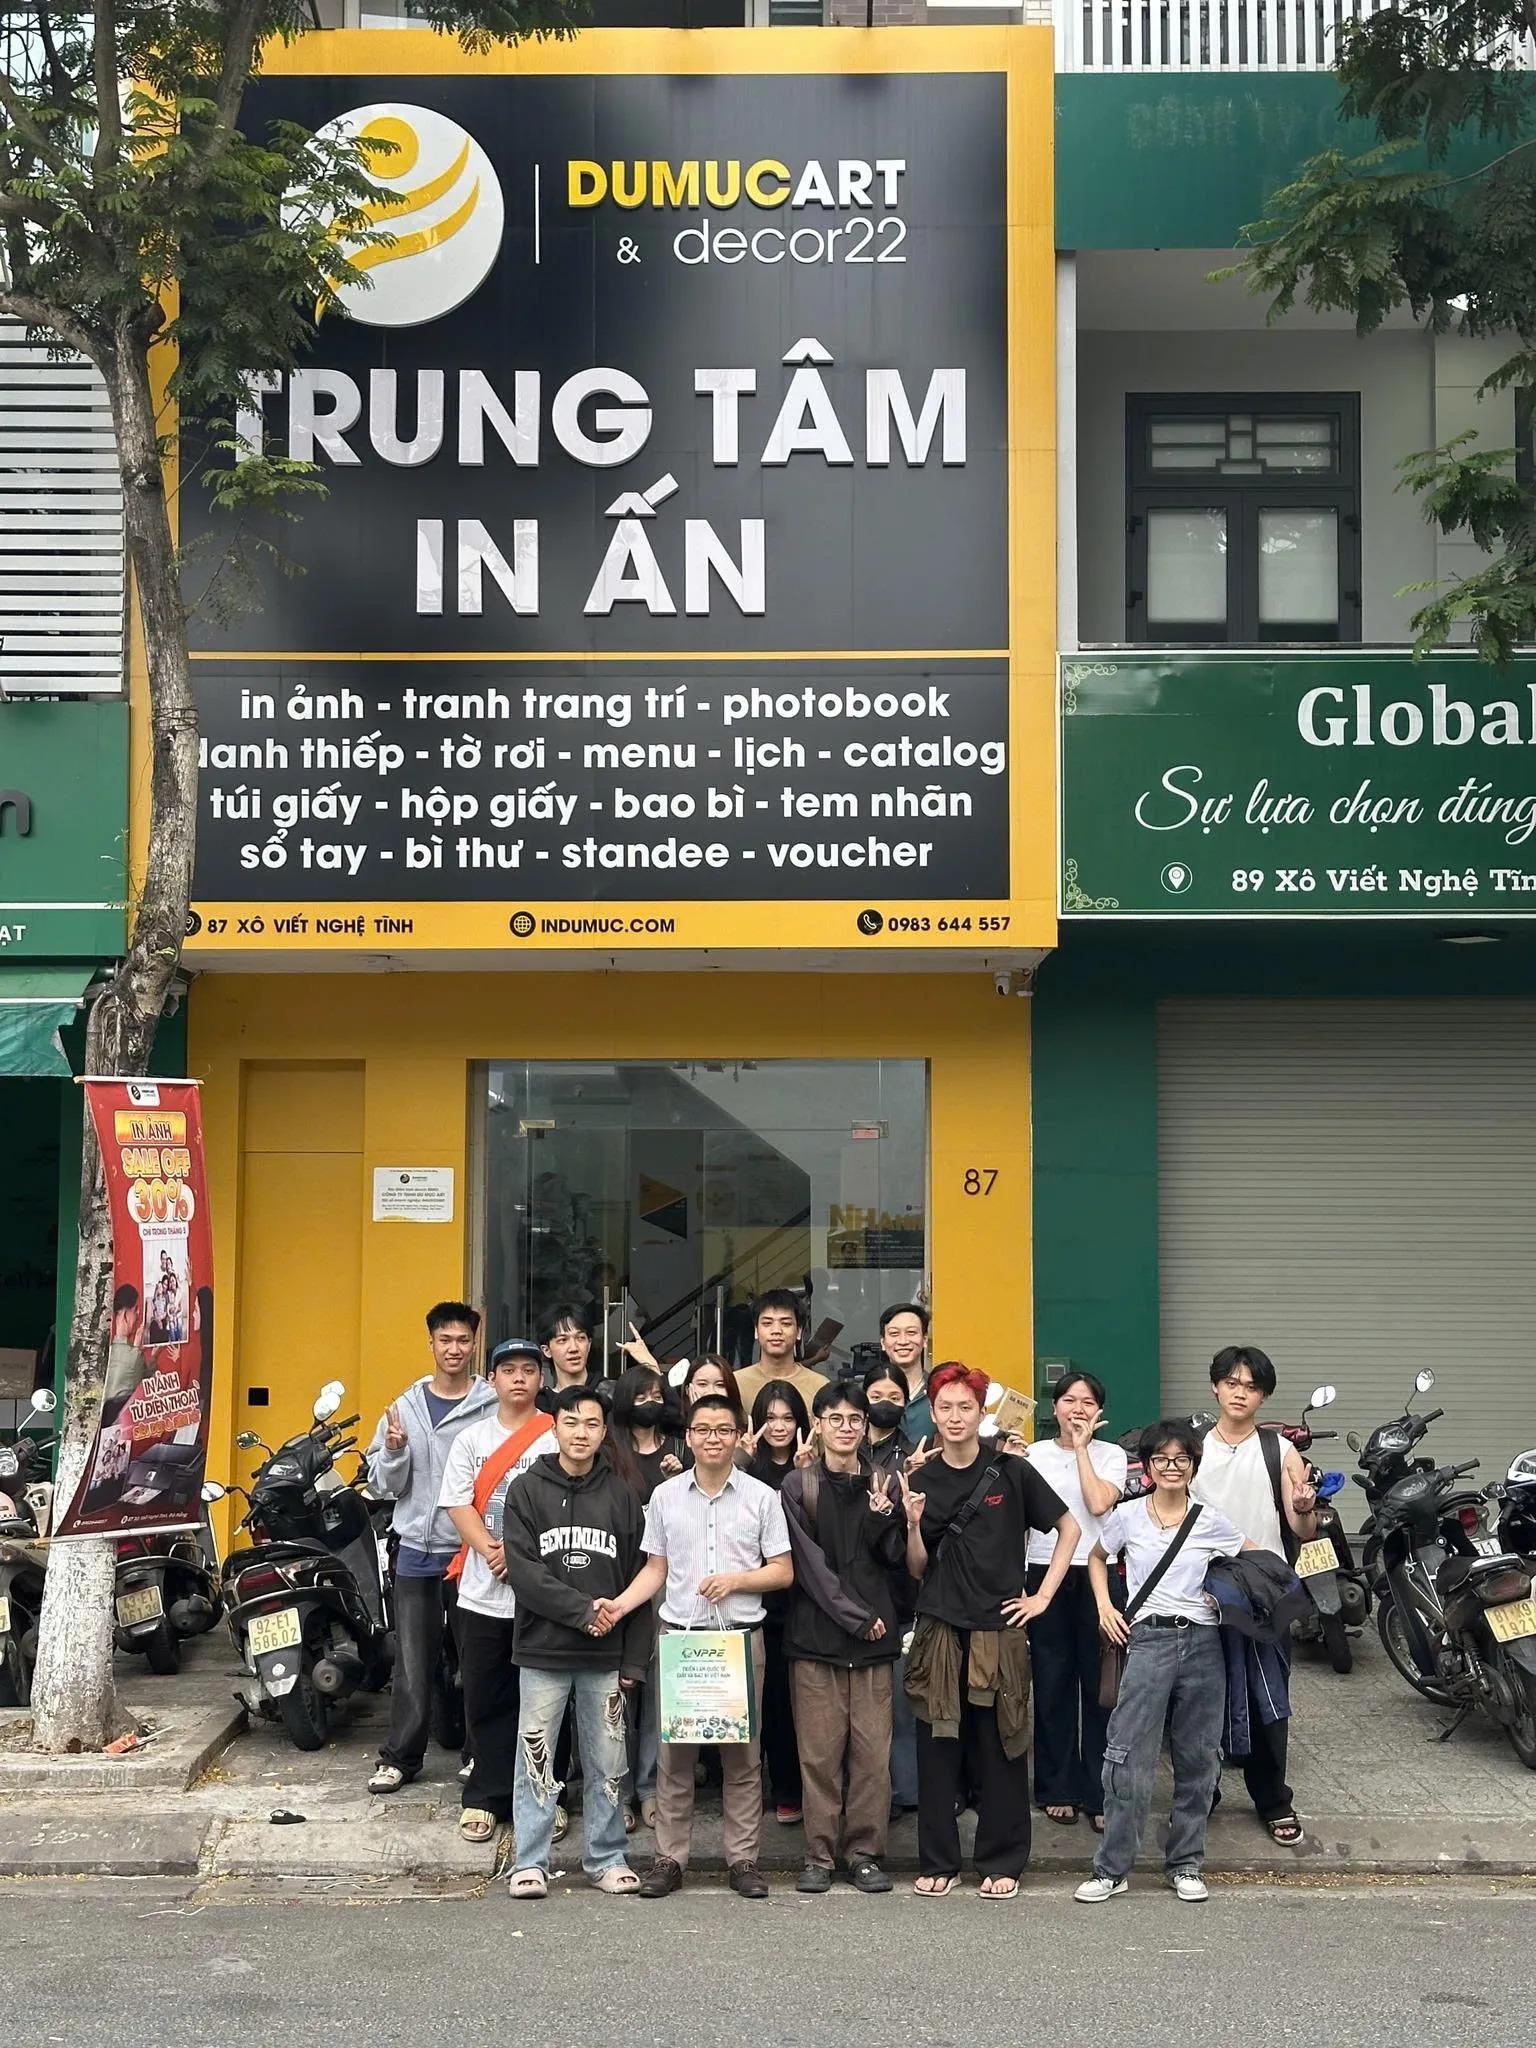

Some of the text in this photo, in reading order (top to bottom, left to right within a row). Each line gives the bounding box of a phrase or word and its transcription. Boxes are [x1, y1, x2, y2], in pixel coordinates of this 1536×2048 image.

[568, 159, 907, 209] DUMUCART
[617, 217, 907, 265] & decor22
[236, 337, 967, 467] TRUNG TÂM
[417, 472, 768, 615] IN ẤN
[242, 688, 274, 719] in
[287, 684, 364, 719] ảnh
[403, 689, 510, 719] tranh
[523, 688, 631, 728] trang
[645, 685, 687, 719] trí
[723, 687, 950, 726] photobook
[301, 731, 405, 776] thiếp
[441, 733, 482, 769] tờ
[495, 737, 545, 769] rơi
[584, 743, 696, 769] menu
[735, 736, 806, 776] lịch
[844, 736, 1006, 775] catalog
[210, 785, 261, 820] túi
[273, 781, 362, 828] giấy
[402, 786, 479, 827] hộp
[490, 781, 579, 828] giấy
[615, 788, 696, 819] bao
[708, 784, 746, 819] bì
[781, 787, 858, 818] tem
[872, 785, 972, 818] nhãn
[1135, 765, 1536, 845] Sự lựa chọn đúng
[241, 829, 291, 869] sổ
[300, 838, 367, 876] tay
[407, 834, 443, 869] bì
[456, 837, 524, 869] thư
[562, 838, 730, 869] standee
[767, 836, 933, 868] voucher
[1232, 869, 1265, 892] 89
[1275, 868, 1316, 892] Xô
[1326, 864, 1388, 892] Viết
[1399, 867, 1479, 898] Nghệ
[208, 912, 413, 937] 87 XÔ VIẾT NGHỆ TĨNH
[541, 918, 675, 934] INDUMUC.COM
[889, 916, 1010, 932] 0983 644 557
[131, 1121, 146, 1141] IN
[121, 1148, 191, 1178] SALE OFF
[964, 1169, 999, 1196] 87
[135, 1178, 190, 1222] 30%
[143, 1379, 156, 1396] IN
[253, 1627, 298, 1652] 586.02
[256, 1613, 290, 1634] 92-E1
